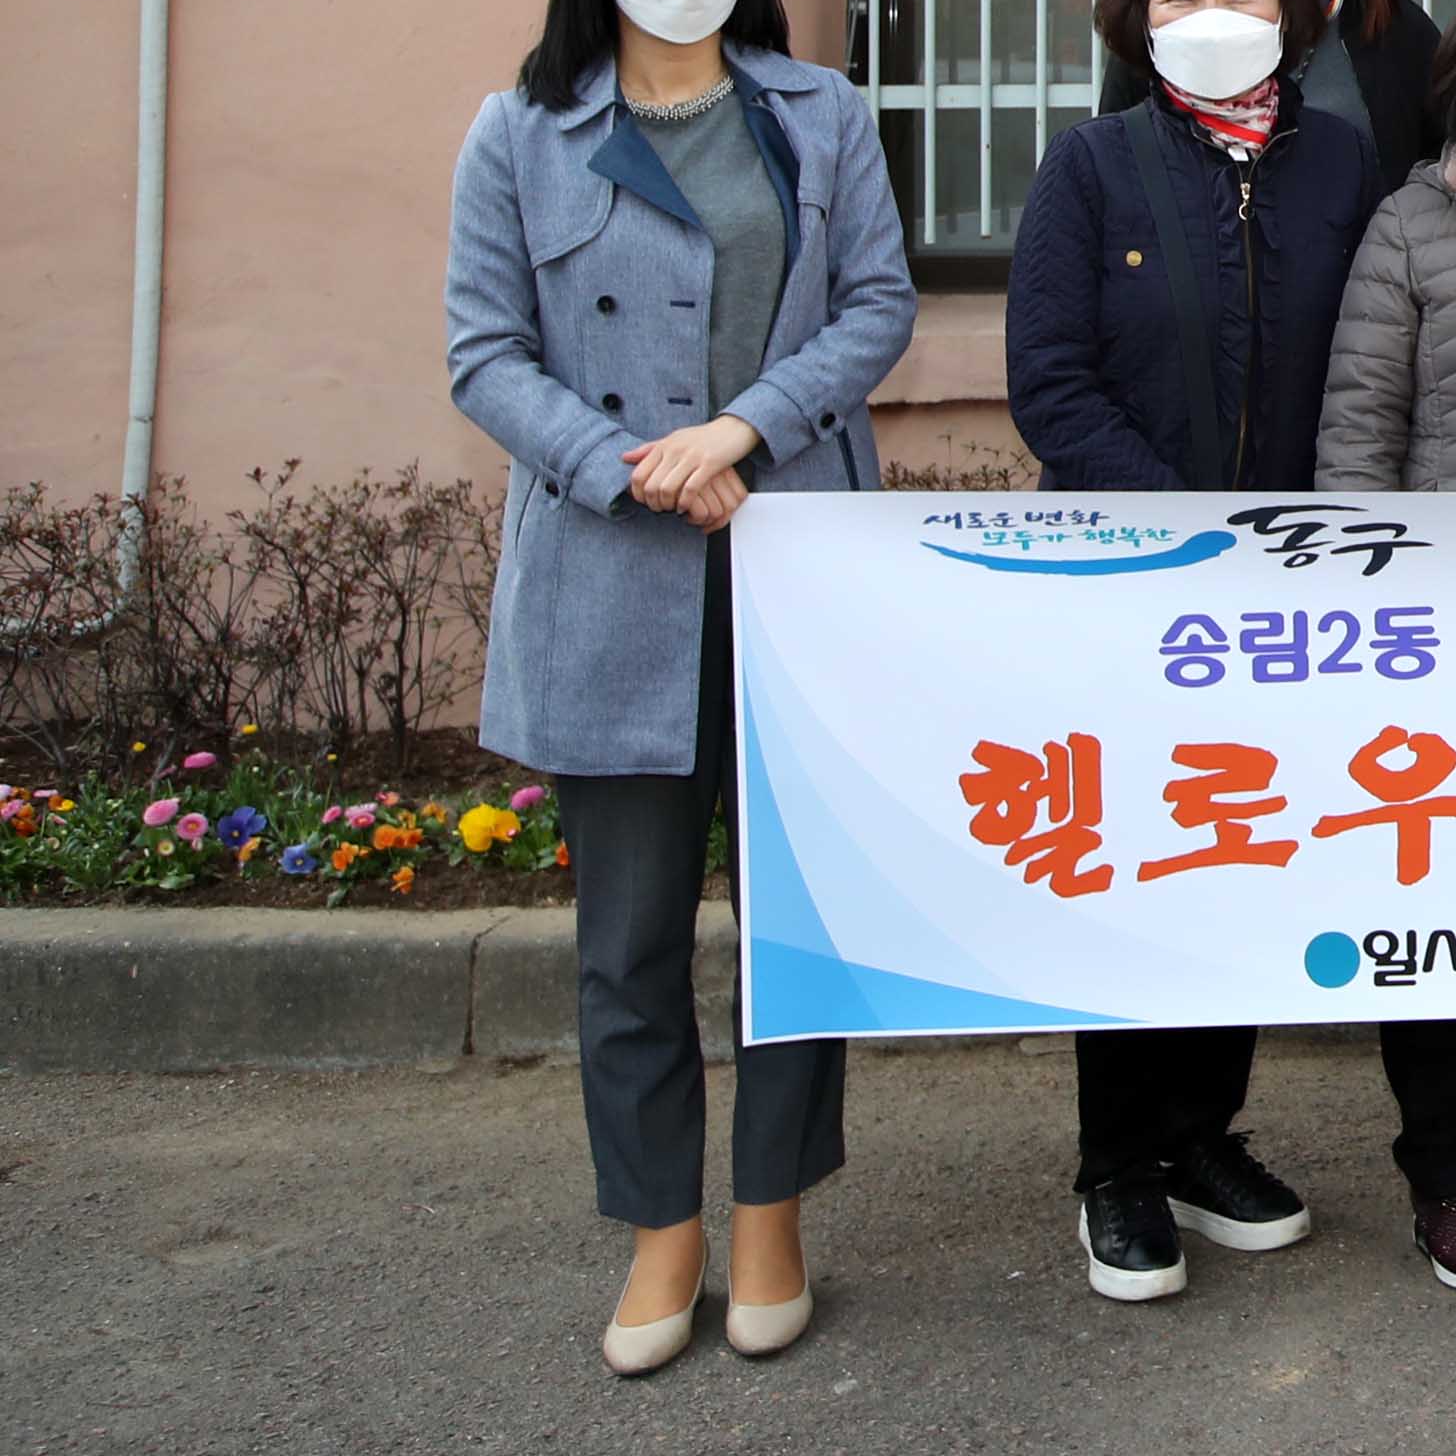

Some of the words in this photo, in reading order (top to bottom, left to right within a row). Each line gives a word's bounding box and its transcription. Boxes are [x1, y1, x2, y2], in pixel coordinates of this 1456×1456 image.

[923, 511, 1018, 530] 새로운
[1024, 509, 1110, 527] 변화
[982, 530, 1073, 551] 모두가
[1081, 526, 1176, 547] 행복한
[1226, 504, 1434, 577] 동구
[1159, 606, 1441, 688] 송림2동
